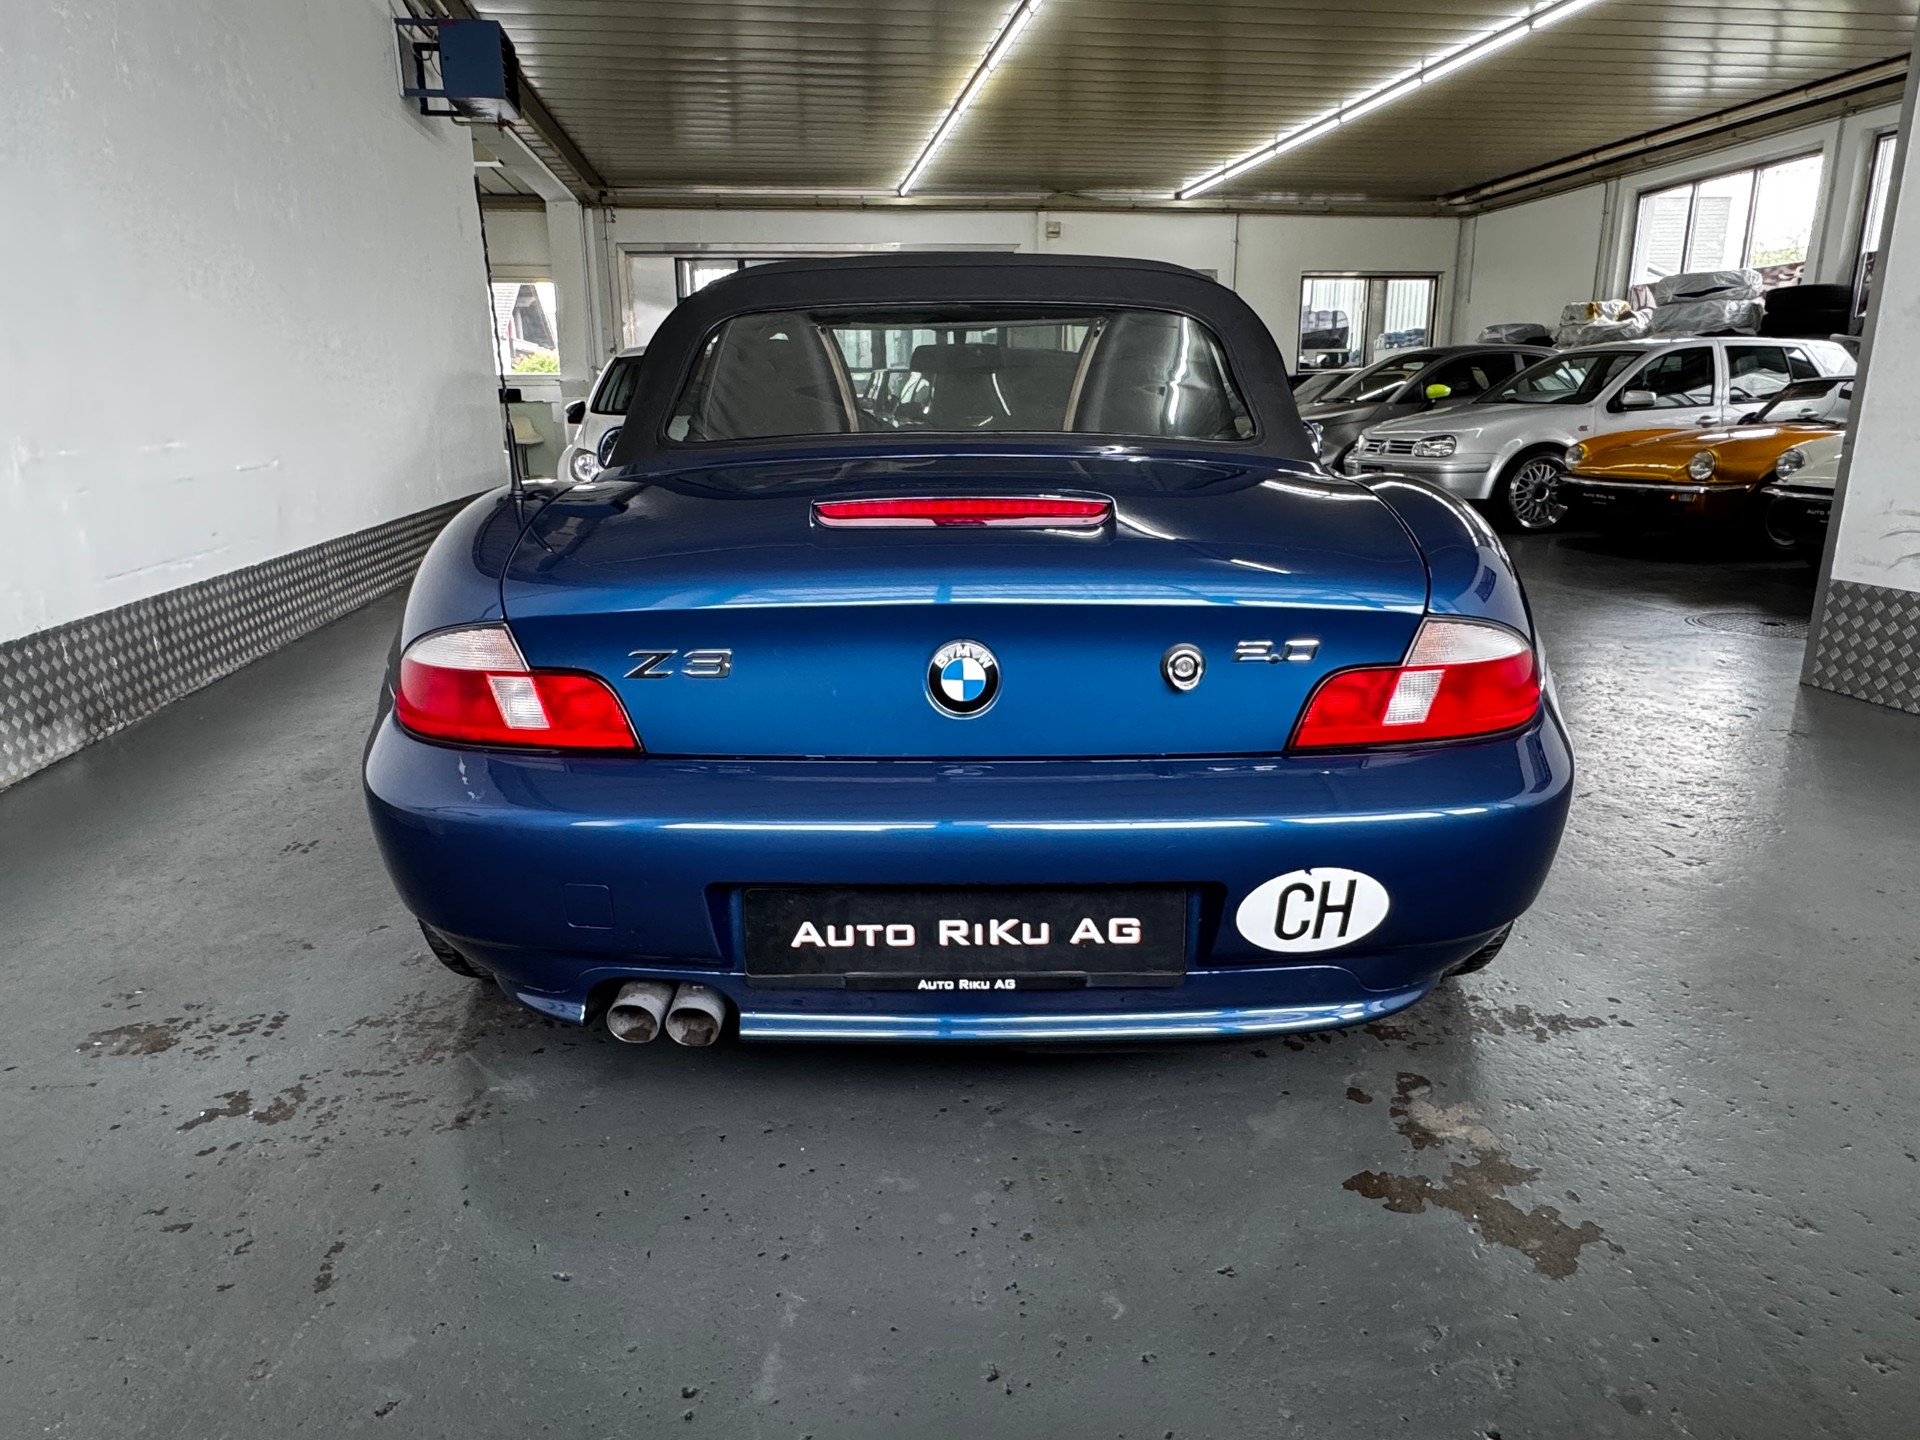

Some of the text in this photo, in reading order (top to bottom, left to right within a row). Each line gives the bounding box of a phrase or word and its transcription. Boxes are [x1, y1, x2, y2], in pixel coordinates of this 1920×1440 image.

[623, 648, 733, 679] Z3
[933, 644, 994, 669] BMW
[1231, 639, 1320, 664] 2.0
[1274, 879, 1357, 941] CH
[790, 920, 916, 948] AUTO
[1069, 917, 1142, 945] AG
[993, 978, 1017, 990] AG
